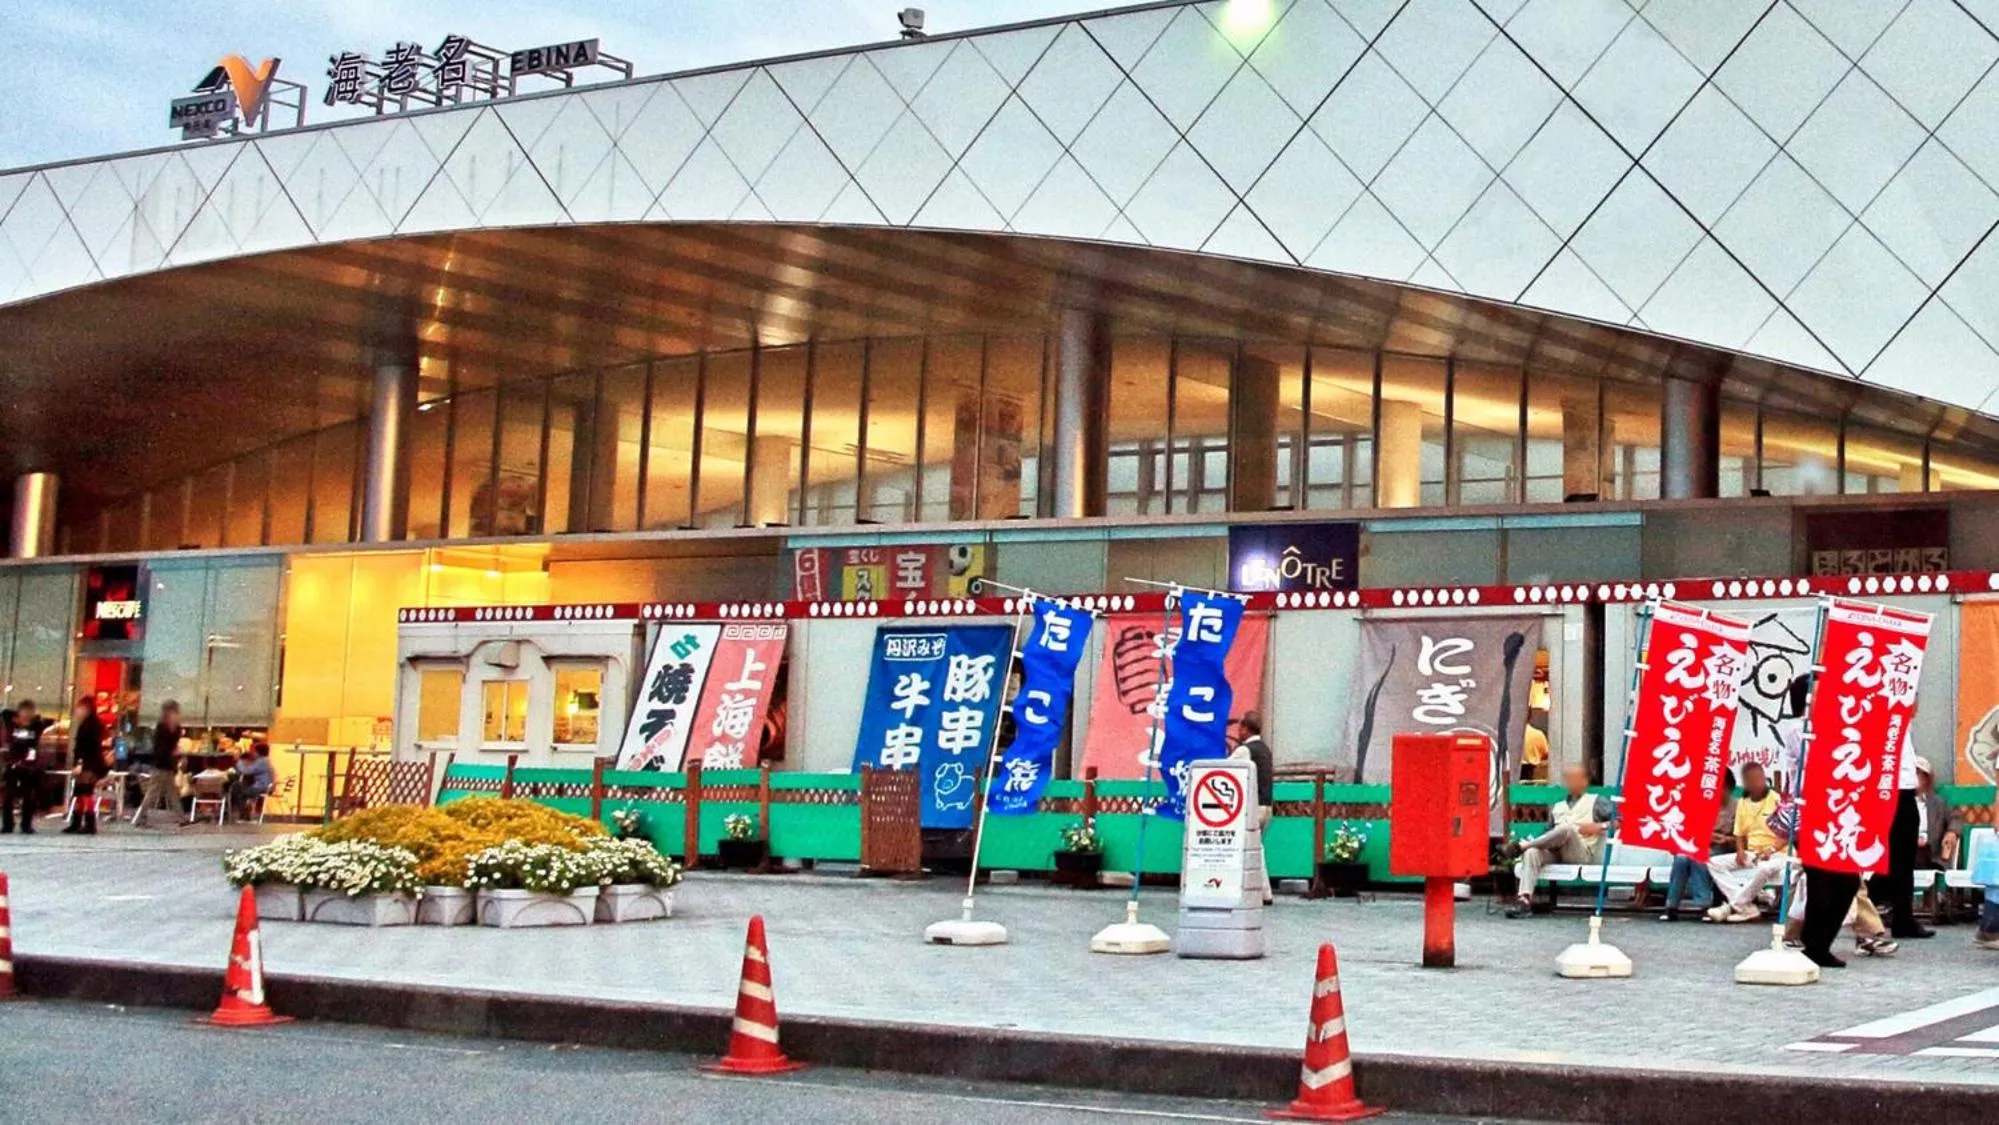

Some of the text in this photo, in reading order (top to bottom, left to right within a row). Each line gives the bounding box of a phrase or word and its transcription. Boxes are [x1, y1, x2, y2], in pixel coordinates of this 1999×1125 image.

[328, 34, 469, 104] 海老名
[512, 41, 589, 72] EBINA
[171, 98, 226, 118] NEXCO
[848, 549, 879, 564] 宝くじ
[1713, 654, 1735, 699] 名物
[1889, 652, 1912, 697] 名物
[880, 672, 931, 771] 牛串
[938, 654, 995, 755] 豚串
[1813, 631, 1885, 868] えびえび焼
